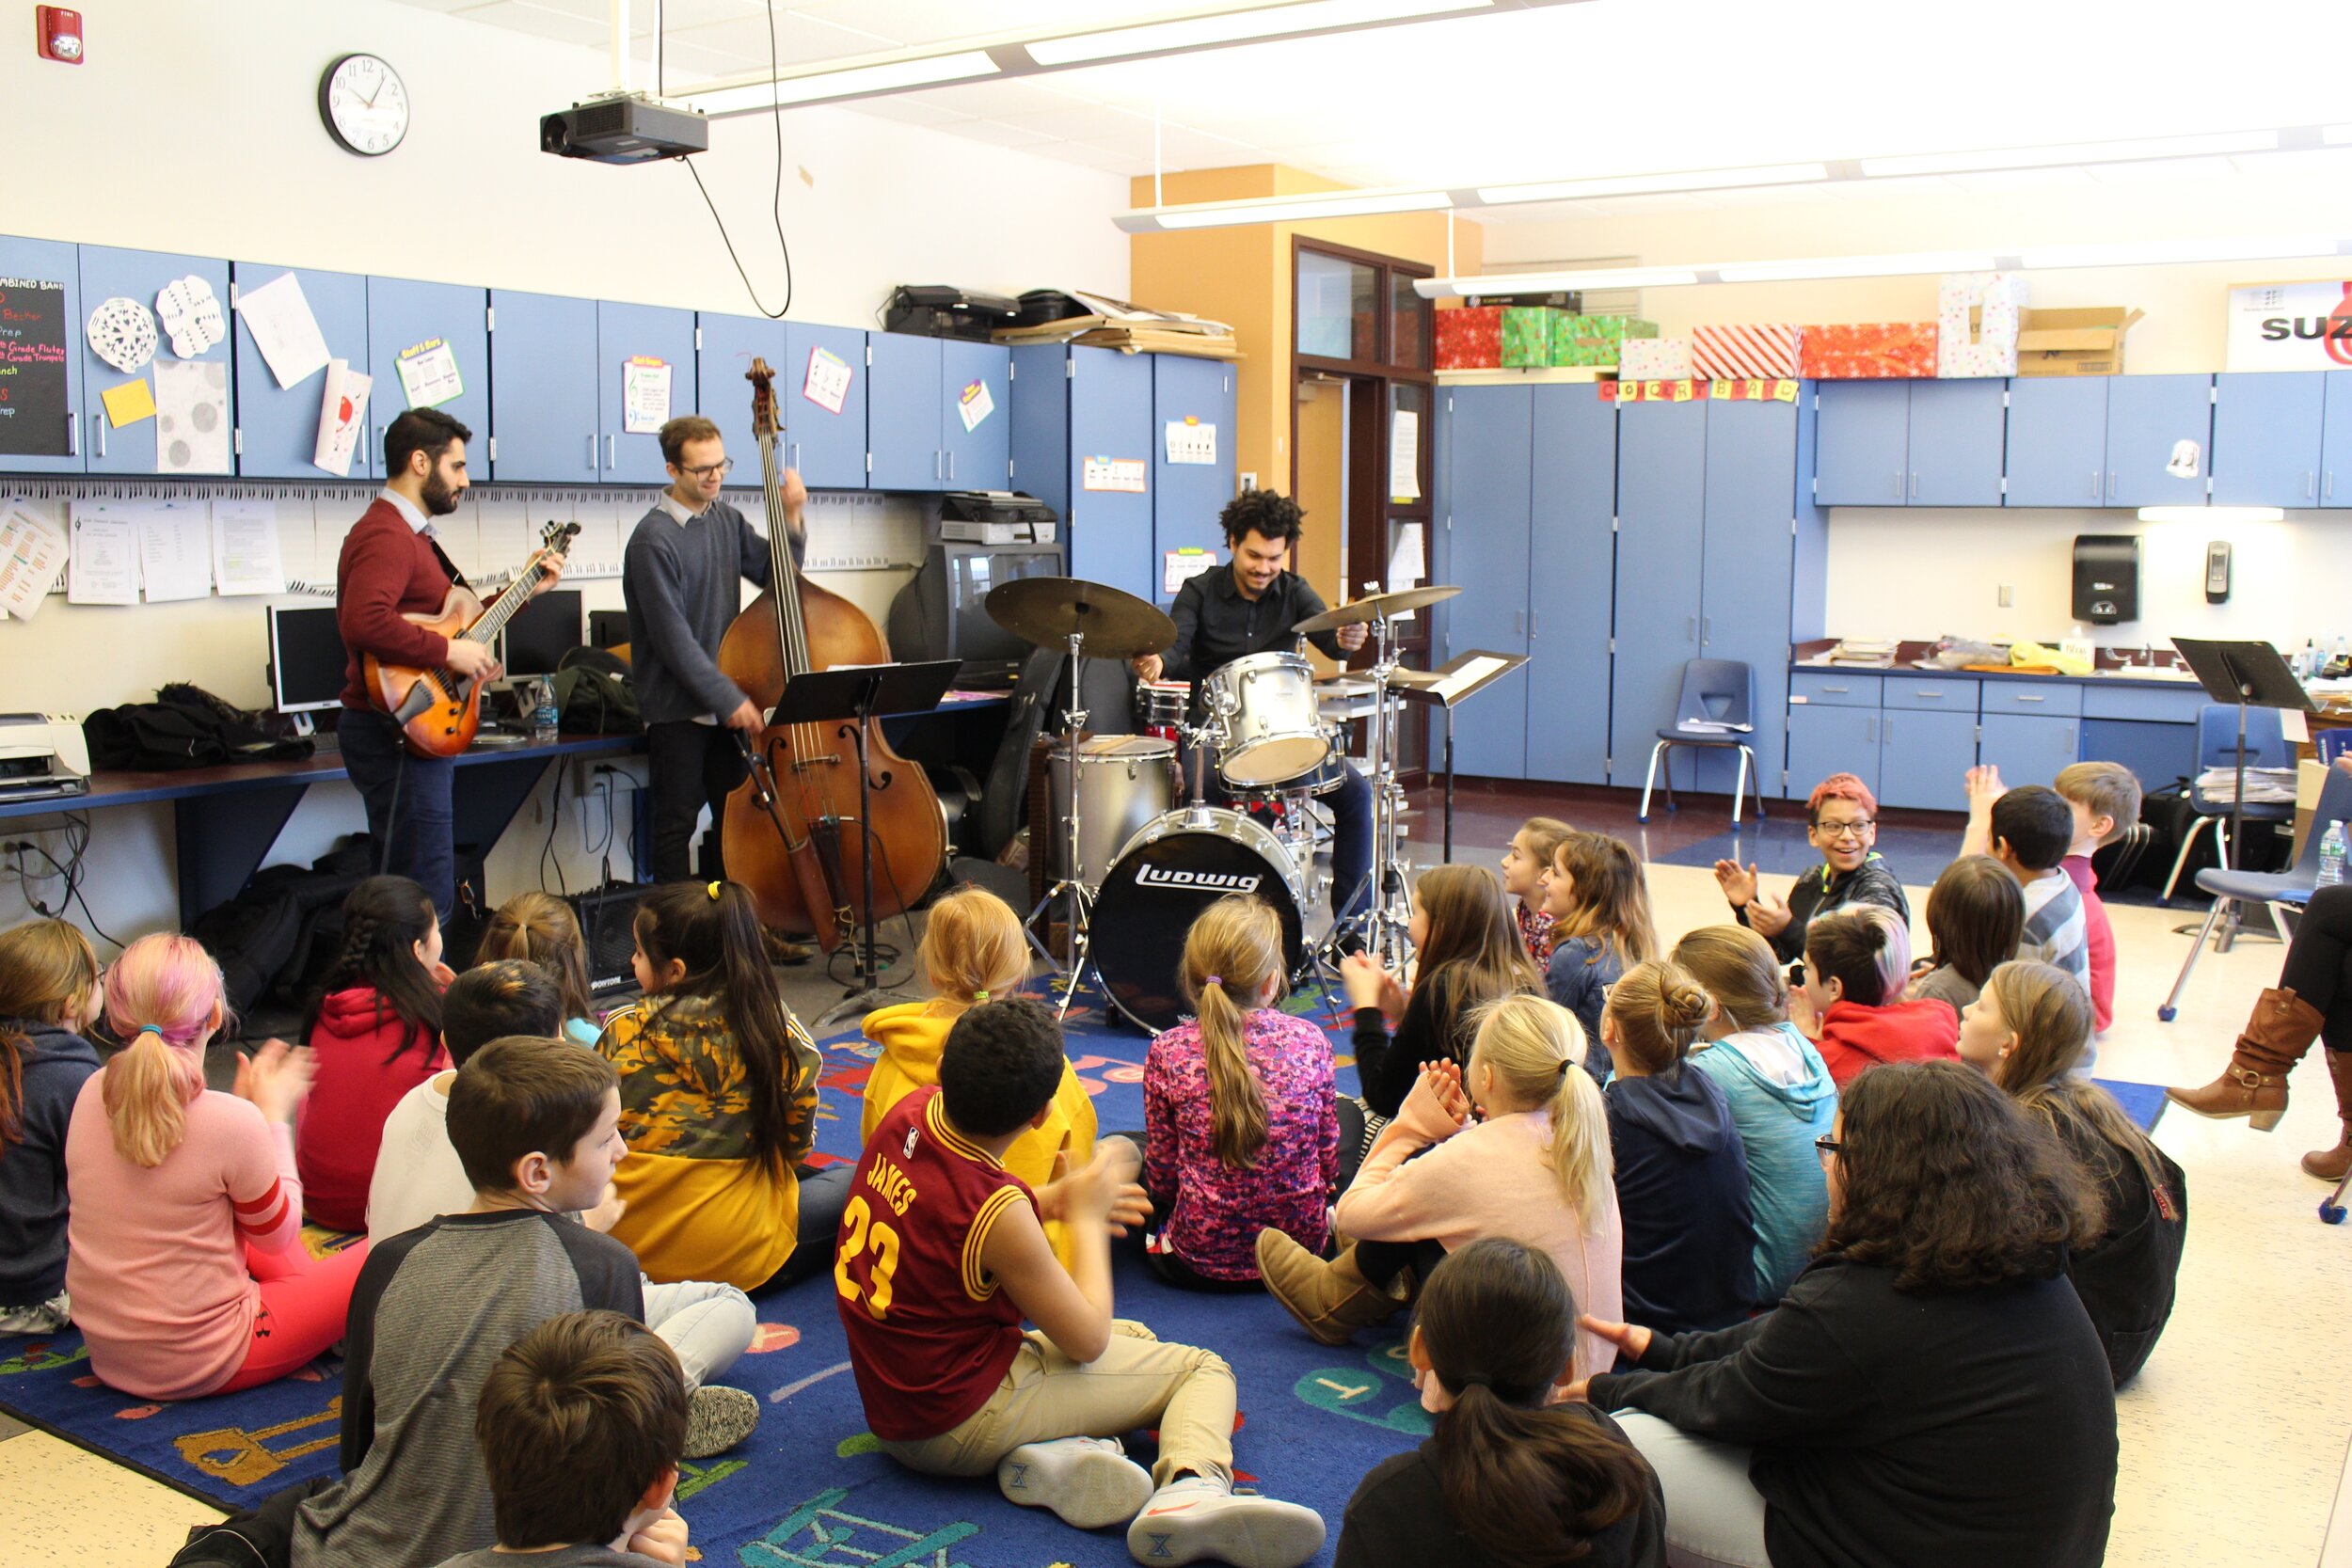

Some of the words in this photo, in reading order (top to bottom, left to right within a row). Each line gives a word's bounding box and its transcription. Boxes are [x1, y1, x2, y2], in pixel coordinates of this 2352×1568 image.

[349, 64, 357, 76] 11
[362, 59, 374, 73] 12
[335, 75, 346, 89] 10
[390, 83, 399, 96] 2
[332, 95, 340, 108] 9
[367, 136, 374, 150] 6
[382, 134, 389, 147] 5
[40, 280, 64, 291] BAND
[8, 341, 35, 354] Grade
[39, 343, 64, 356] Flutes
[8, 353, 32, 362] Grade
[33, 353, 64, 364] Trumpets
[1716, 381, 1792, 396] BOARD
[866, 1152, 917, 1217] JAMES
[834, 1195, 900, 1321] 23
